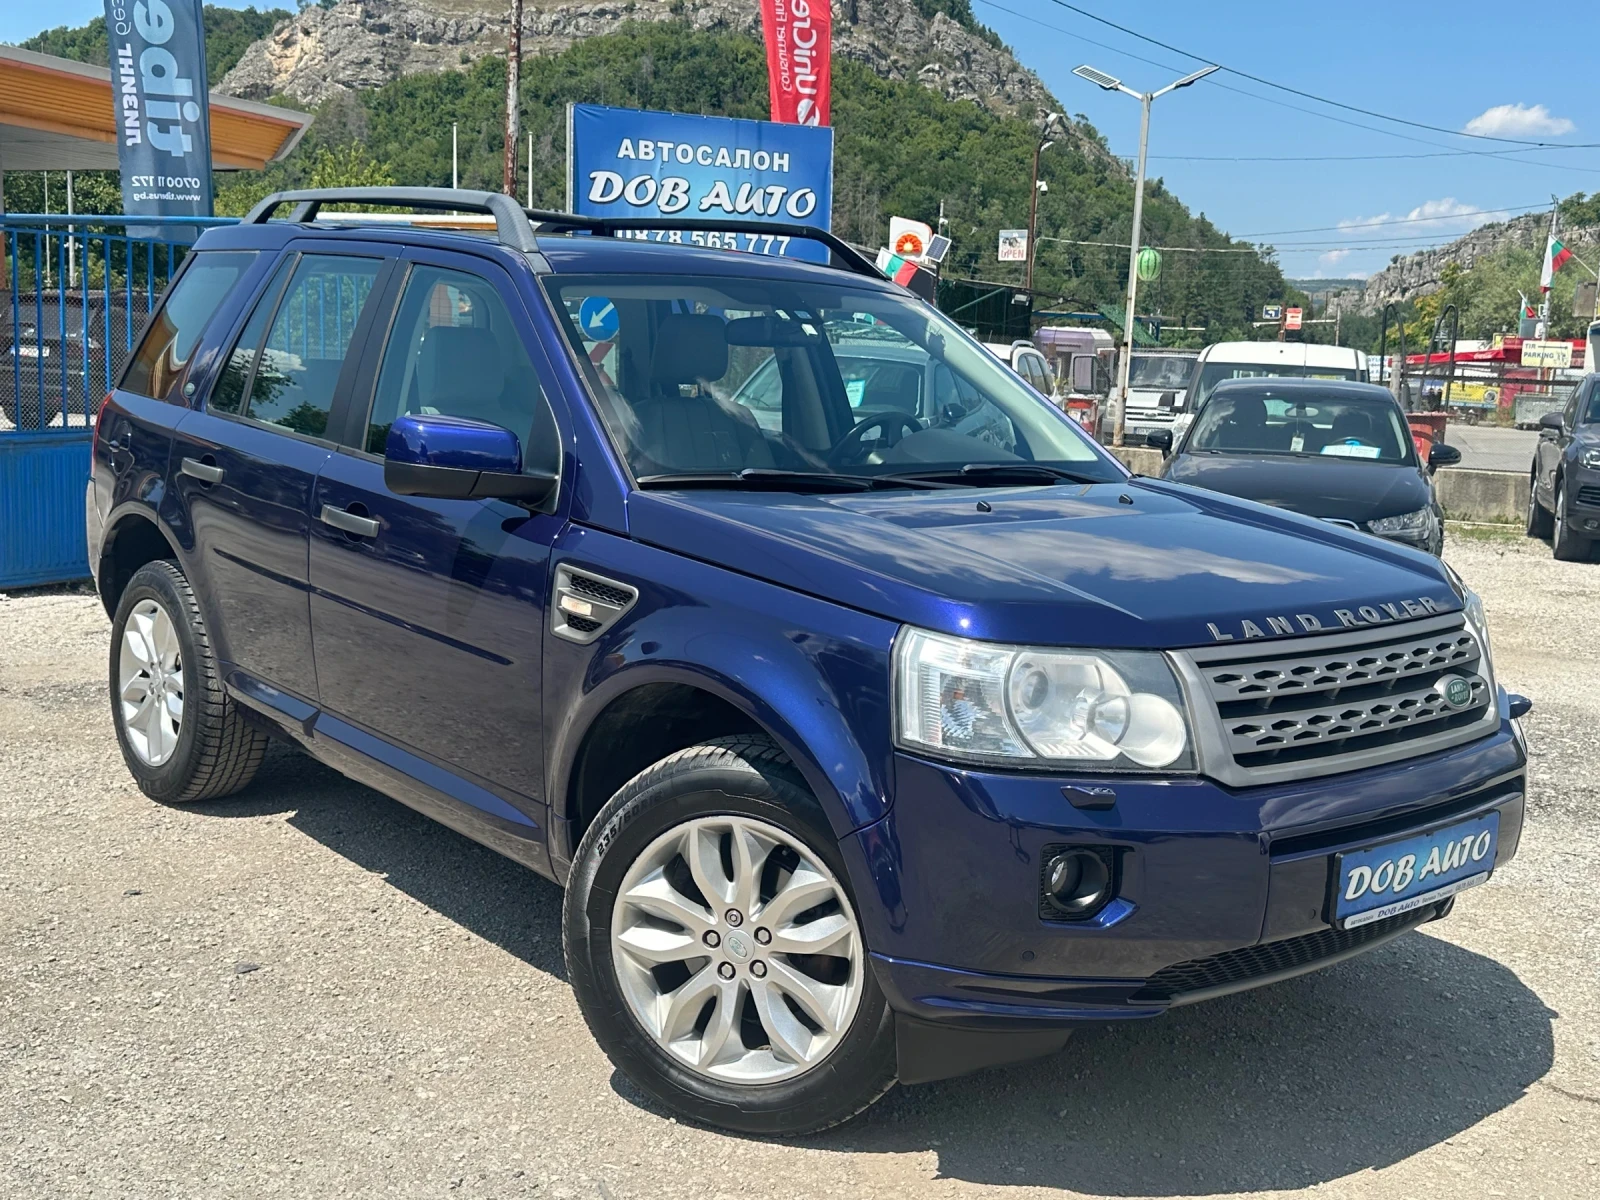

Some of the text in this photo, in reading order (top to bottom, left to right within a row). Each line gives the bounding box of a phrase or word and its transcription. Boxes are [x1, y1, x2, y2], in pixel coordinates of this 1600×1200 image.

[617, 138, 790, 173] АВТОСАЛОН
[588, 170, 816, 218] DOB AUTO
[691, 230, 738, 250] 565
[745, 233, 791, 256] 777
[1523, 351, 1554, 359] PARKING
[1207, 596, 1439, 641] LAND ROVER
[1344, 829, 1491, 900] DOB AUTO
[1377, 906, 1397, 918] DOB
[1397, 900, 1420, 912] AUTO
